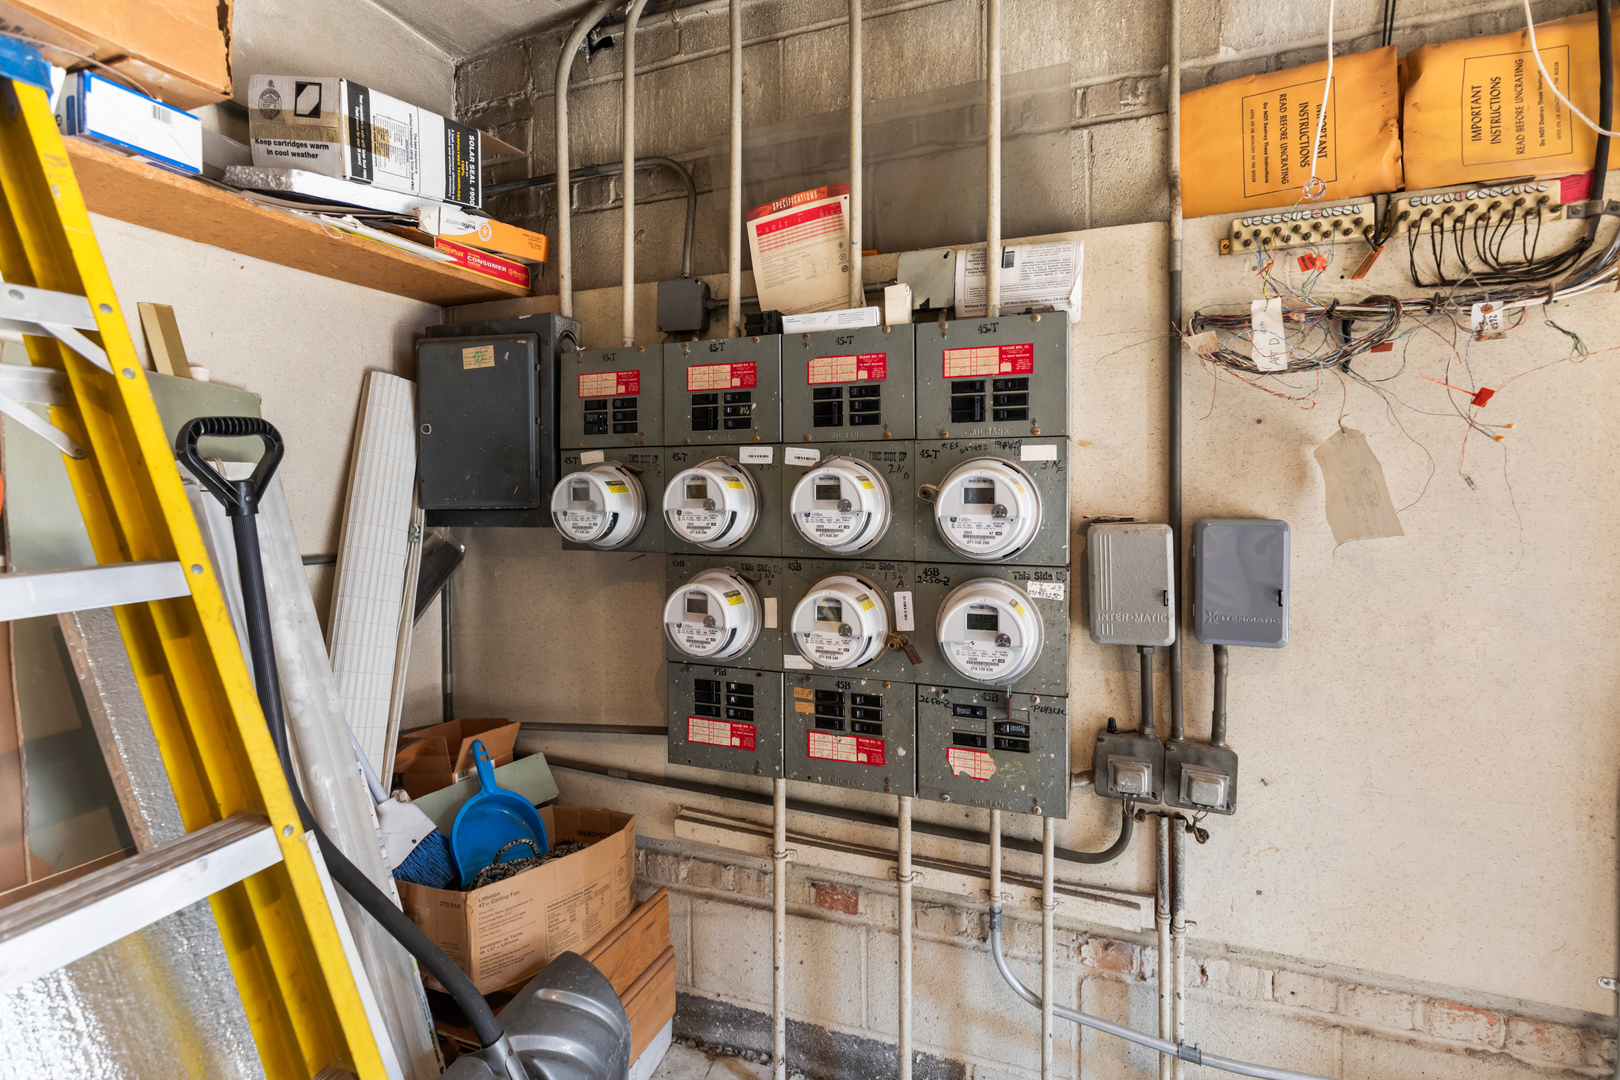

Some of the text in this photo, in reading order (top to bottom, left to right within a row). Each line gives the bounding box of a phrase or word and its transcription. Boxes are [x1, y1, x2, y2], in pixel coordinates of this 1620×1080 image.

[1490, 76, 1501, 144] INSTRUCTIONS
[1515, 59, 1525, 154] READ BEFORE UNCRATING
[1471, 85, 1482, 141] IMPORTANT
[1299, 102, 1310, 168] INSTRUCTIONS
[254, 138, 272, 146] Keep
[274, 140, 308, 149] cartridges
[1280, 142, 1289, 184] UNCRATING
[772, 190, 818, 211] SPECIFICATIONS
[467, 255, 507, 272] CONSUMER
[969, 427, 1010, 435] MILBANK
[868, 452, 881, 461] THIS
[884, 452, 898, 461] SIDE
[740, 563, 754, 571] This
[787, 563, 802, 571] 45B
[879, 562, 895, 570] Side
[922, 567, 940, 576] 45B
[1012, 571, 1031, 581] This
[1033, 572, 1053, 580] Side
[1096, 612, 1167, 623] INTER-MATIC
[713, 667, 727, 676] 45B
[835, 681, 851, 690] 45B
[981, 692, 999, 702] 45B
[829, 777, 865, 787] MILBANK
[971, 798, 1010, 809] MILBANK
[478, 892, 500, 903] Littleton
[491, 895, 509, 904] Ceiling
[479, 939, 502, 950] Ventilador
